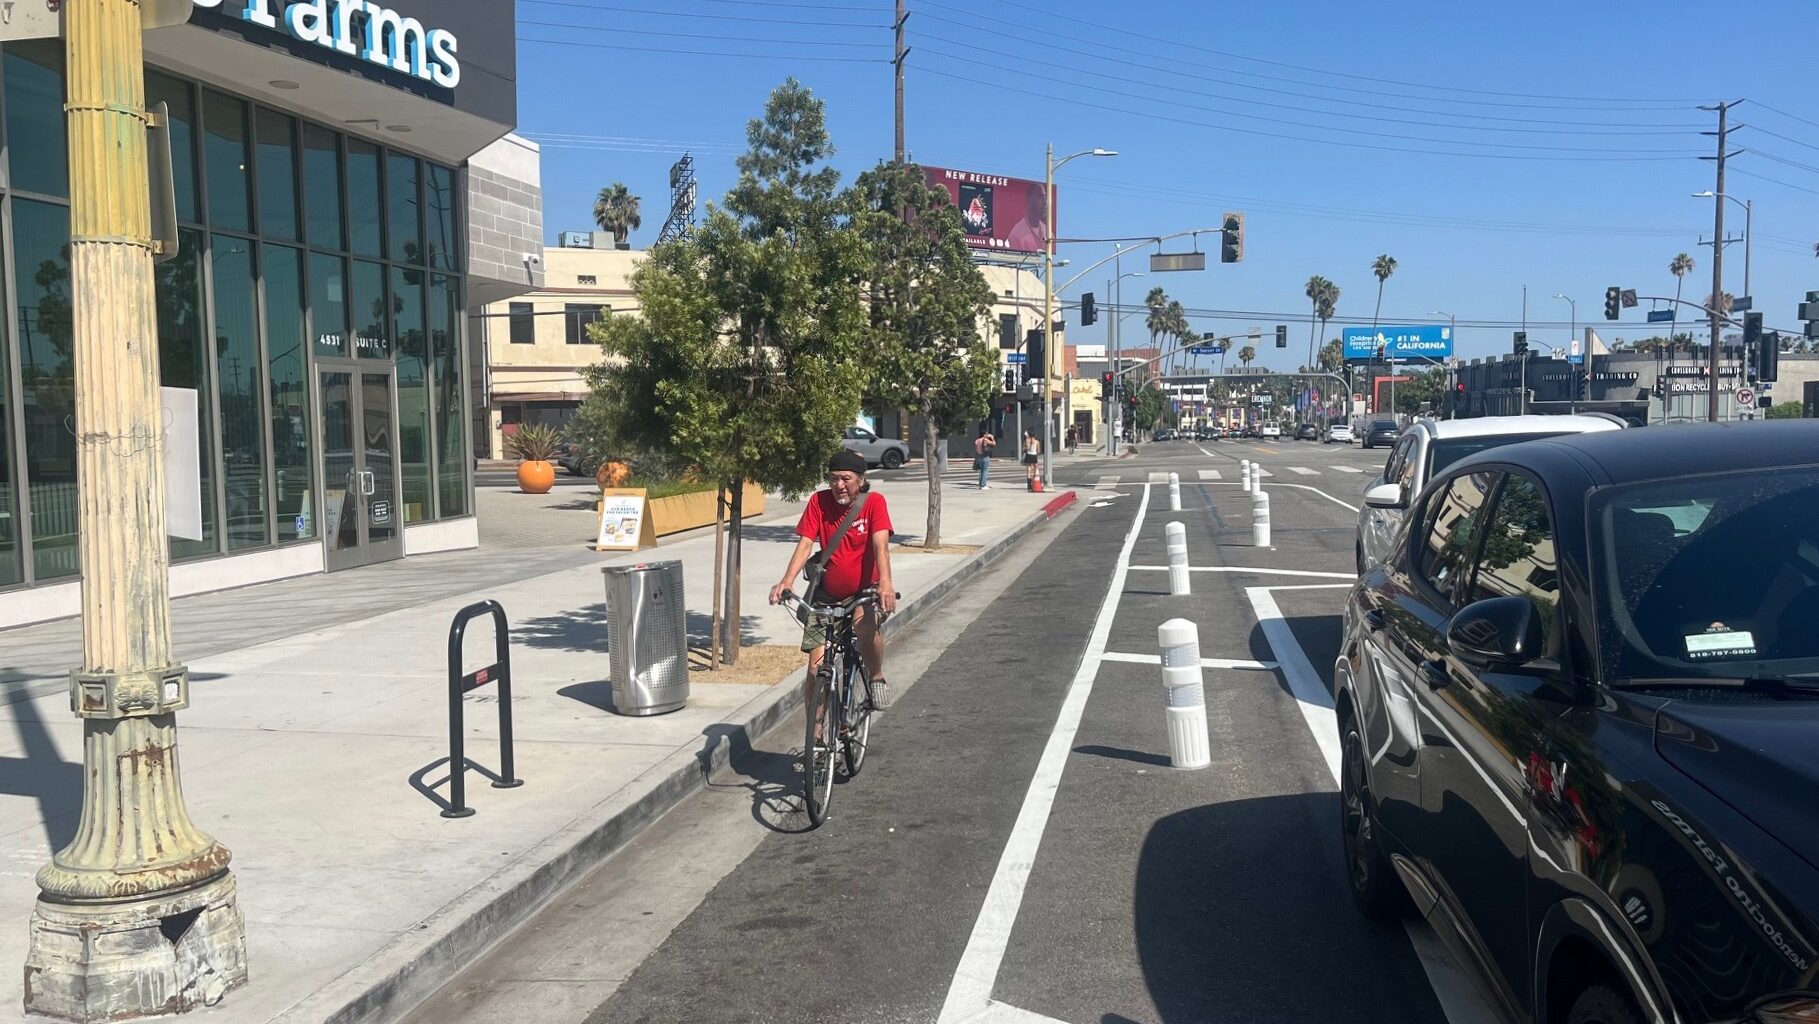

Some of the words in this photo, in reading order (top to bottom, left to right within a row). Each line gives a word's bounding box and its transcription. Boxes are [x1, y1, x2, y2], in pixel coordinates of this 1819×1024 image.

[945, 170, 966, 180] NEW
[970, 173, 1008, 186] RELEASE
[320, 335, 340, 346] 4531
[356, 338, 379, 348] SUITE
[381, 339, 387, 348] C
[1396, 342, 1446, 350] CALIFORNIA
